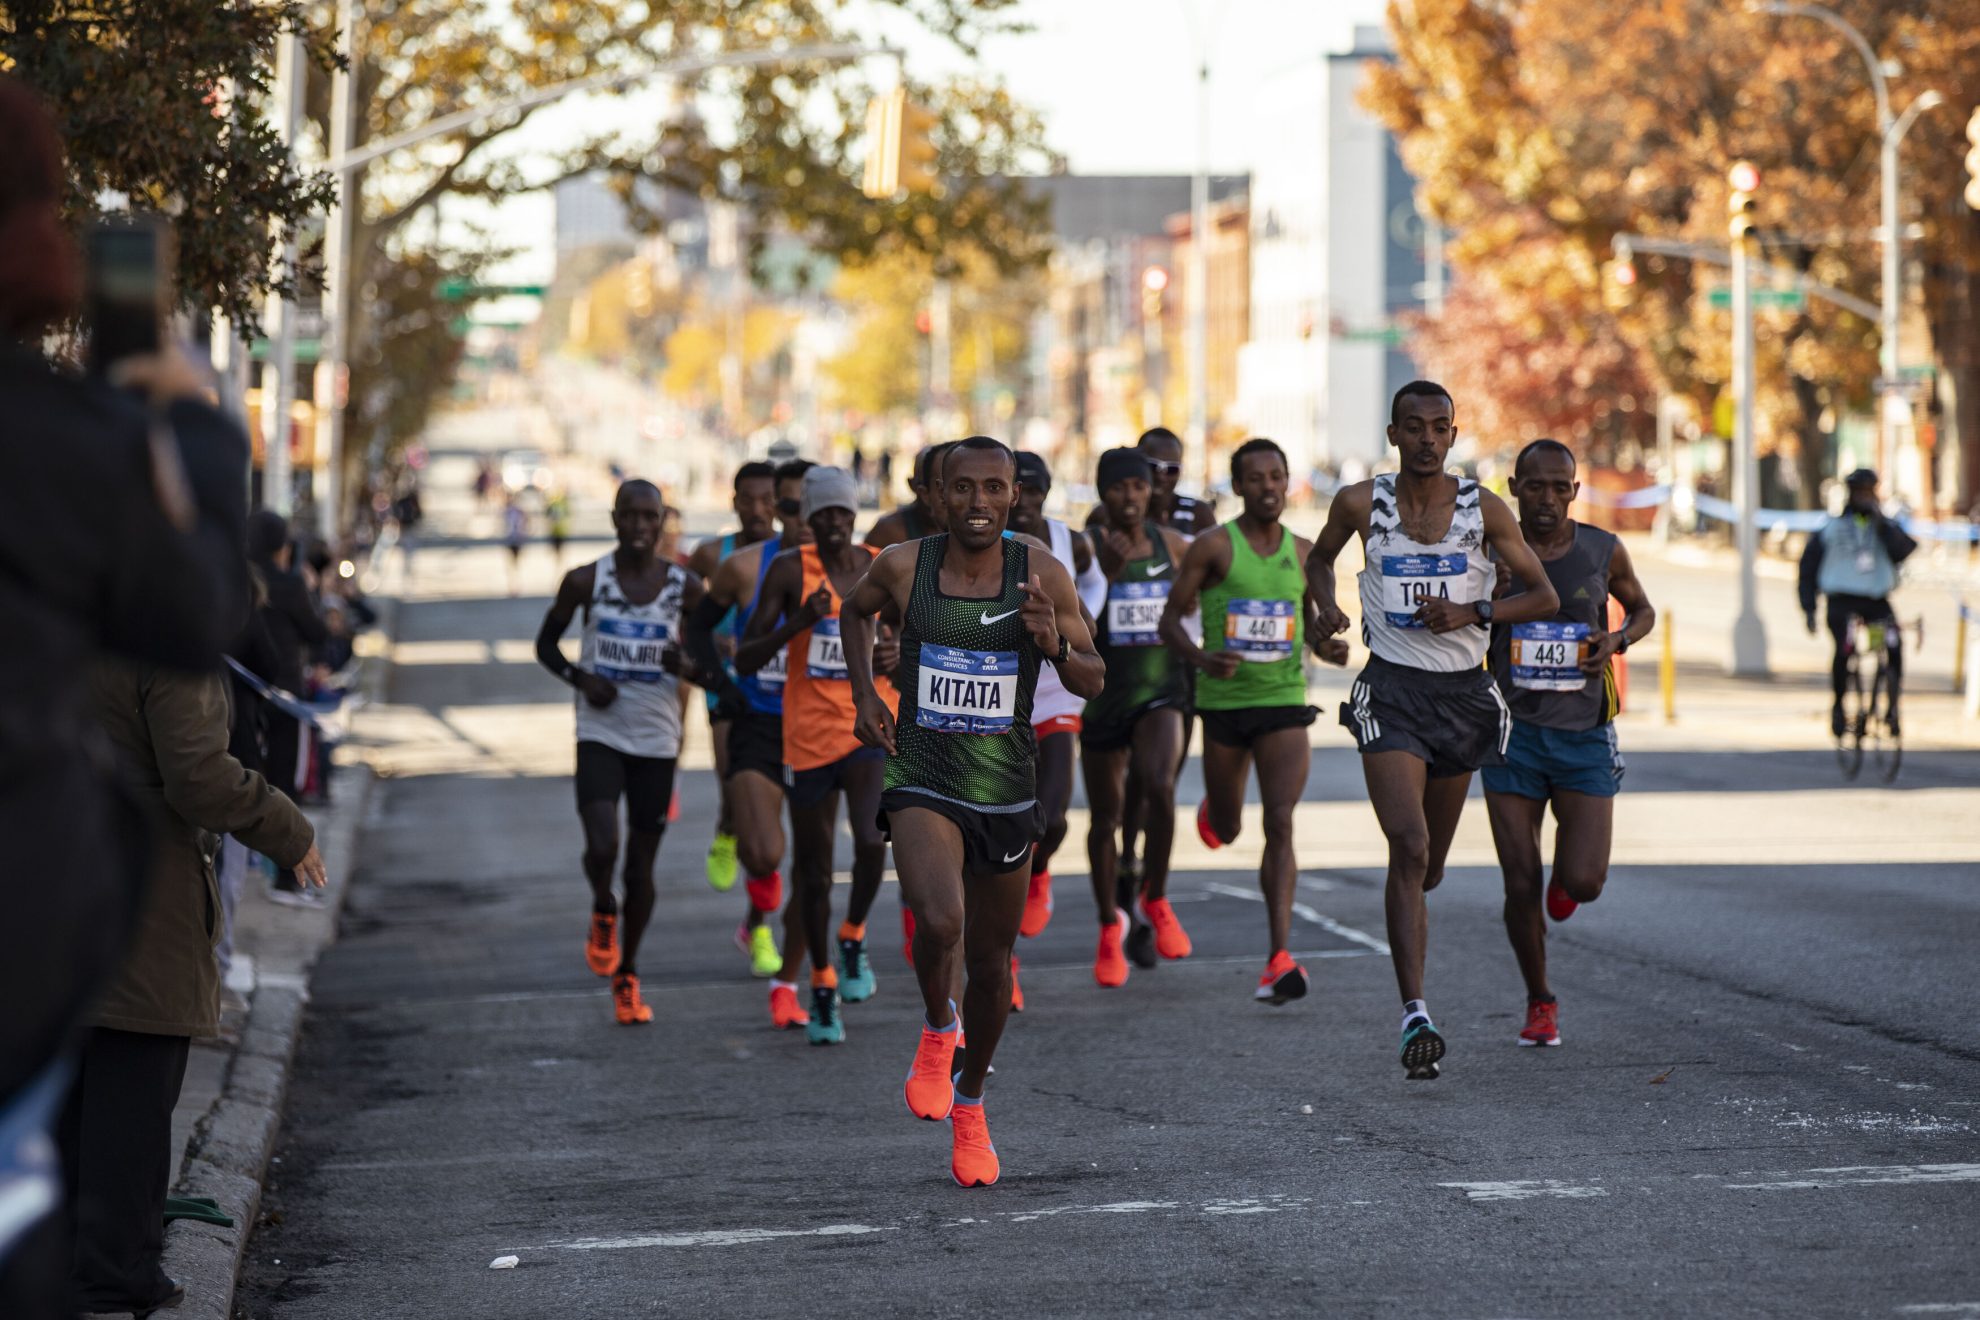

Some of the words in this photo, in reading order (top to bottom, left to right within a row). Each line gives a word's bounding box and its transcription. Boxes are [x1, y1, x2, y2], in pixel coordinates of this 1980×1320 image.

[1249, 620, 1276, 640] 440
[820, 641, 846, 662] TA
[937, 654, 975, 665] CONSULTANCY
[948, 649, 965, 658] TATA
[1535, 643, 1565, 665] 443
[943, 661, 968, 670] SERVICES
[930, 674, 1001, 709] KITATA
